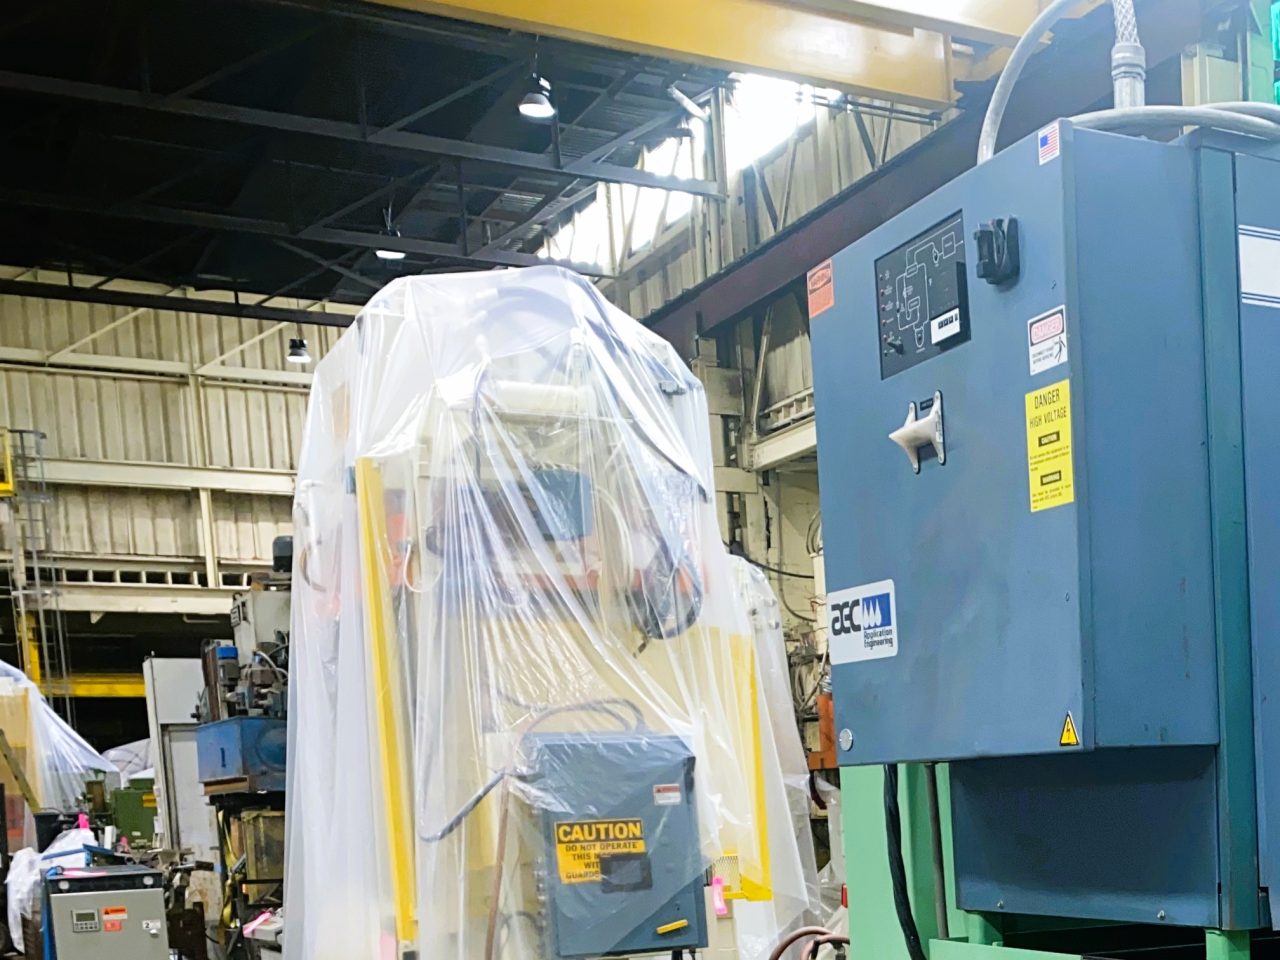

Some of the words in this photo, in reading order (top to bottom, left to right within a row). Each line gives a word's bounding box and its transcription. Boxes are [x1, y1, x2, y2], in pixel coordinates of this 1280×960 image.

[1034, 388, 1060, 409] DANGER
[1029, 415, 1043, 428] HIGH
[1043, 406, 1067, 424] VOLTAGE
[864, 628, 893, 639] Application
[864, 637, 894, 650] Engineering
[558, 823, 640, 842] CAUTION
[565, 844, 578, 852] DO
[580, 843, 597, 851] NOT
[600, 842, 638, 850] OPERATE
[572, 852, 591, 861] THIS
[584, 861, 600, 869] WIT
